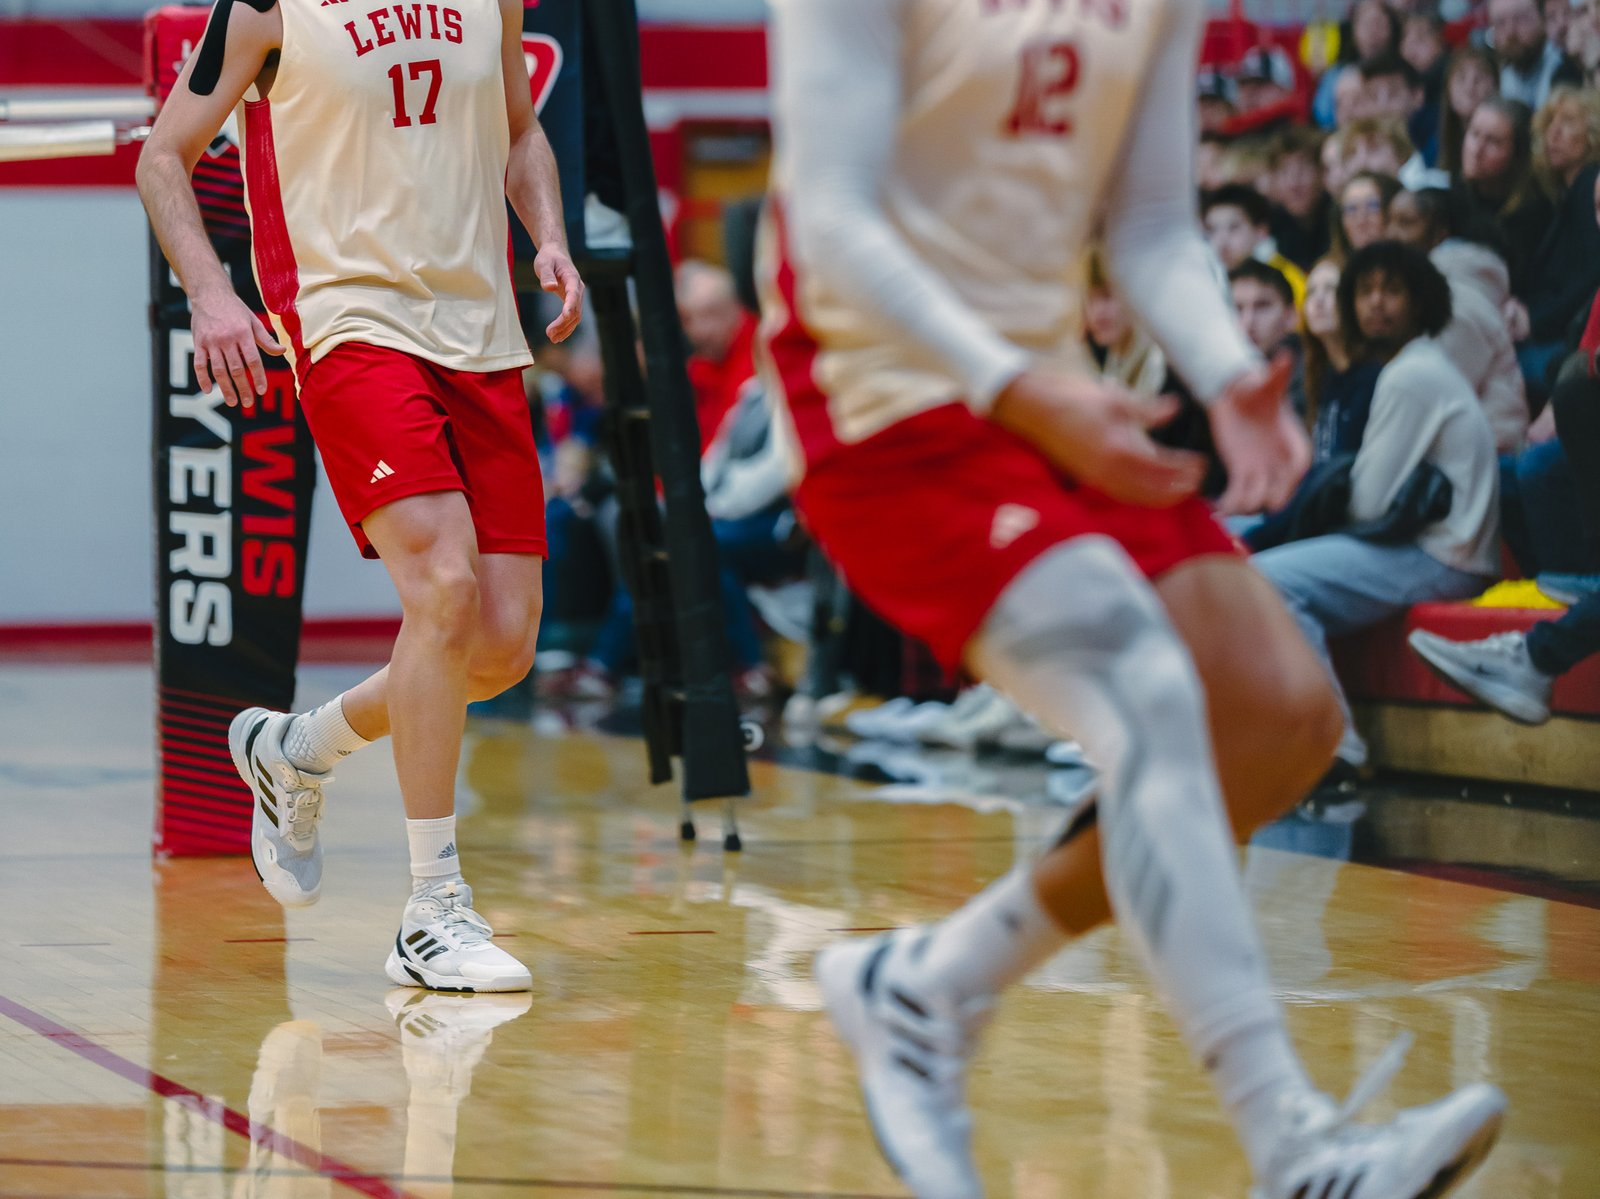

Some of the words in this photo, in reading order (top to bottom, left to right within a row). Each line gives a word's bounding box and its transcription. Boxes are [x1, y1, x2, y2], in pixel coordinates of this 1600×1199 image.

[344, 3, 463, 58] LEWIS
[387, 59, 443, 128] 17
[999, 41, 1083, 139] 12
[169, 262, 233, 647] LYERS
[240, 312, 297, 598] EWIS
